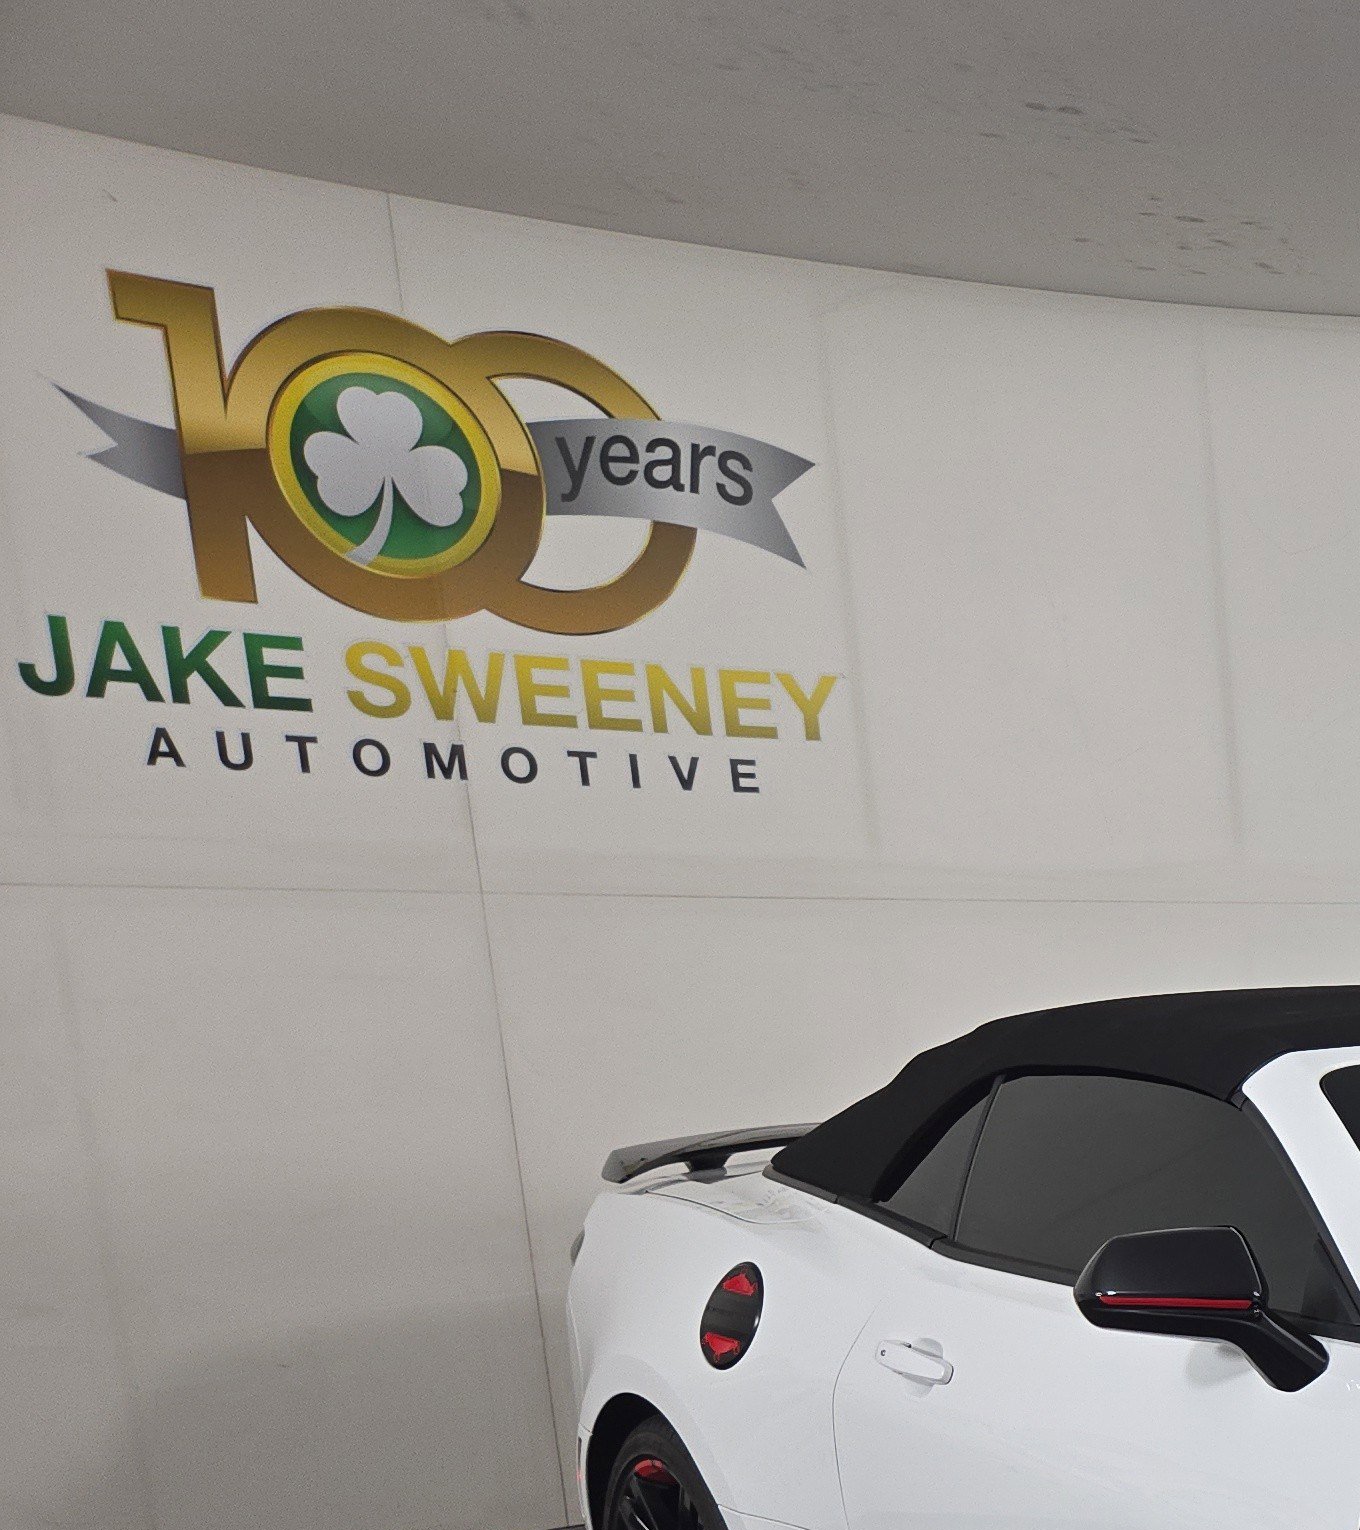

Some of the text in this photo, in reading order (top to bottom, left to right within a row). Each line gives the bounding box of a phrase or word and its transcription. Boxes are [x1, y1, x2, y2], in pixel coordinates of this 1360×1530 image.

[106, 268, 698, 635] 100
[554, 433, 756, 507] years
[17, 614, 840, 741] JAKE SWEENEY
[146, 726, 762, 794] AUTOMOTIVE
